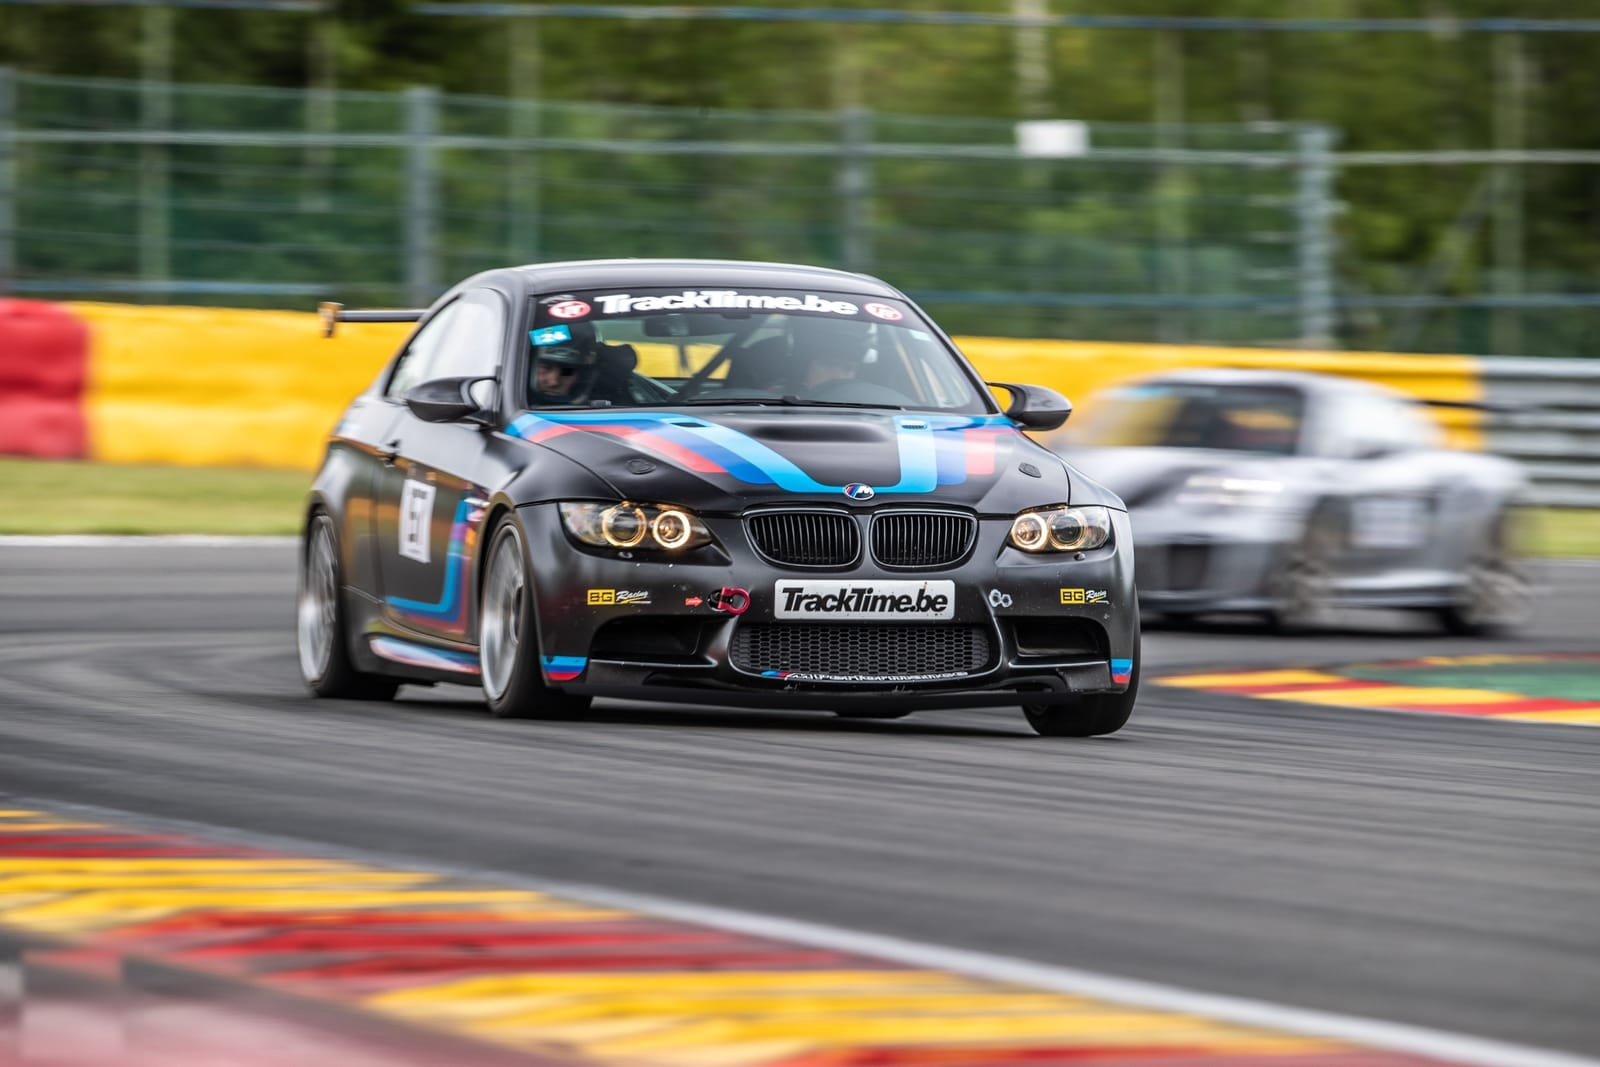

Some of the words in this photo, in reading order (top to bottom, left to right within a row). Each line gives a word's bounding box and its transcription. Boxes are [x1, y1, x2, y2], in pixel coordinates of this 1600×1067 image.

[593, 291, 859, 315] TrackTime.be
[589, 591, 613, 603] BG
[782, 584, 948, 612] TrackTime.be
[1062, 590, 1084, 602] BG
